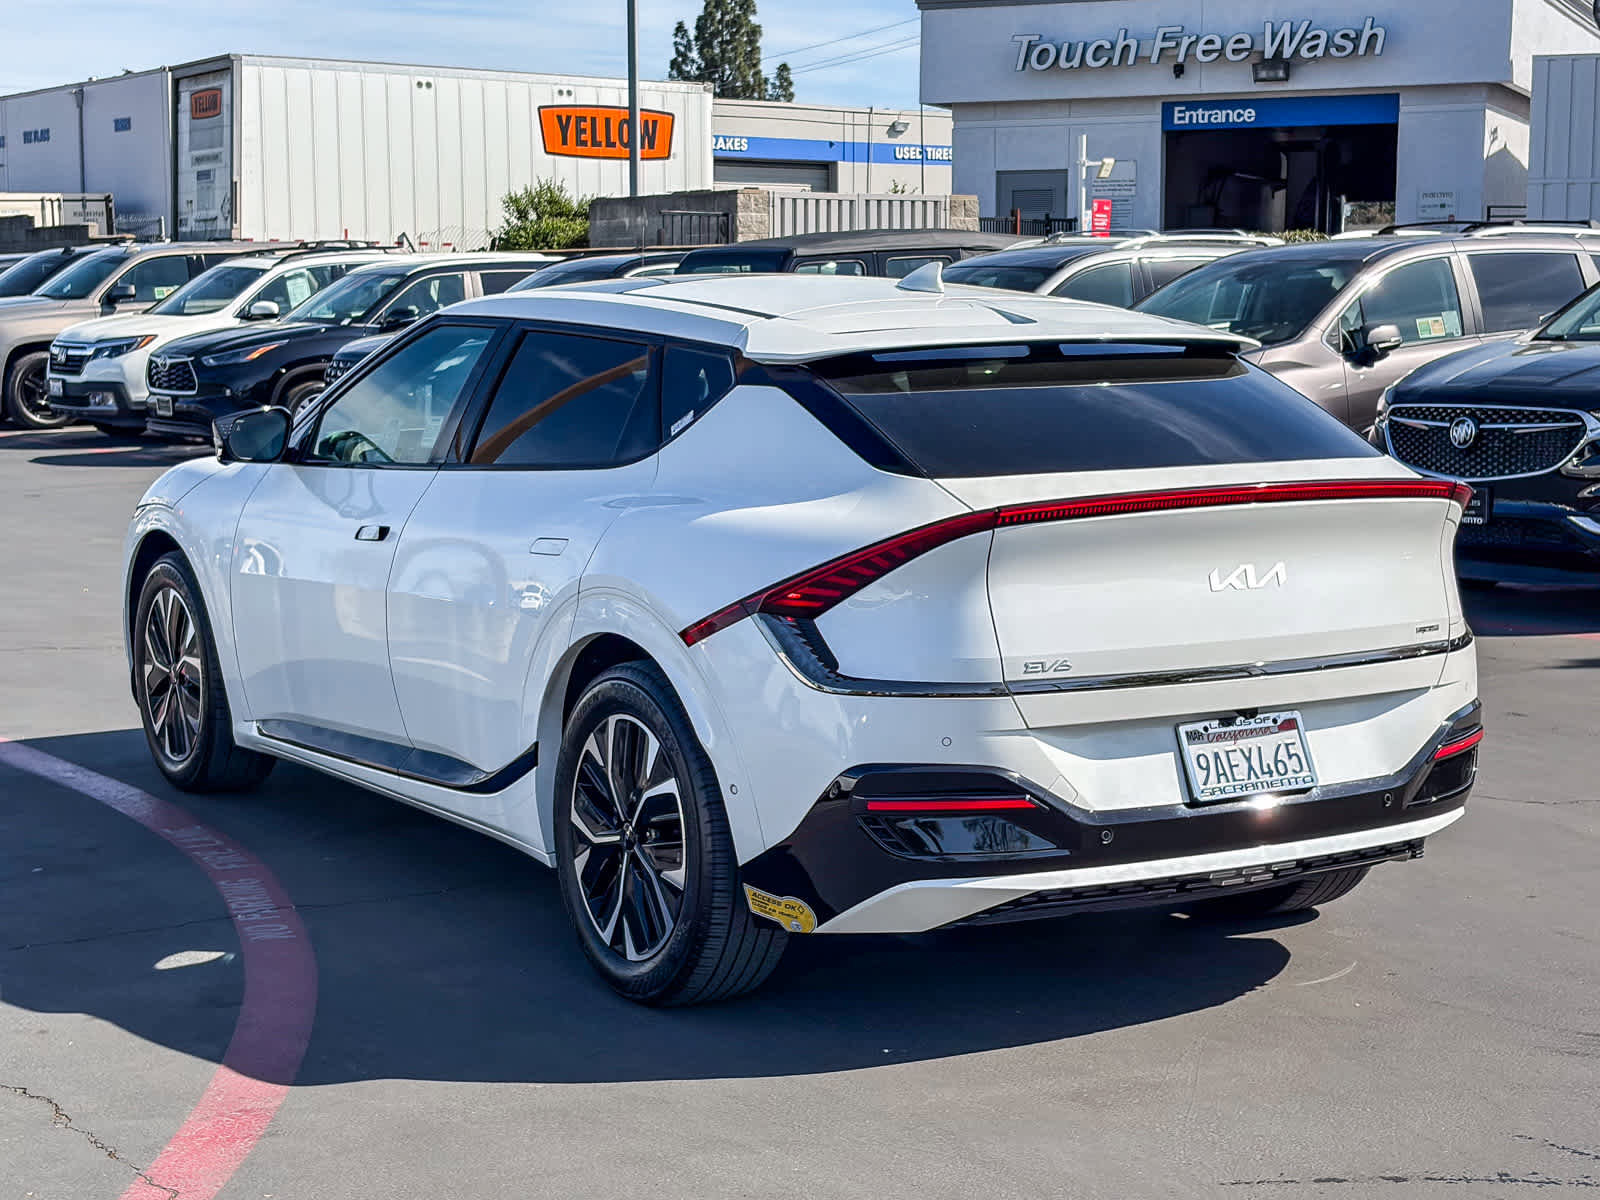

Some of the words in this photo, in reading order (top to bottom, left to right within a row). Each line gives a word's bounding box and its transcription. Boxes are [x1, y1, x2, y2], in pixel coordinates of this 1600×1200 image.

[1011, 27, 1138, 72] Touch
[1150, 25, 1252, 64] Free
[1263, 16, 1387, 60] Wash
[1173, 106, 1256, 125] Entrance
[556, 114, 659, 150] YELLOW
[895, 146, 923, 159] USED
[1208, 560, 1288, 593] KIA
[1023, 659, 1072, 674] EV6
[1196, 742, 1303, 786] 9AEX465
[1200, 776, 1314, 796] SACRAMENTO
